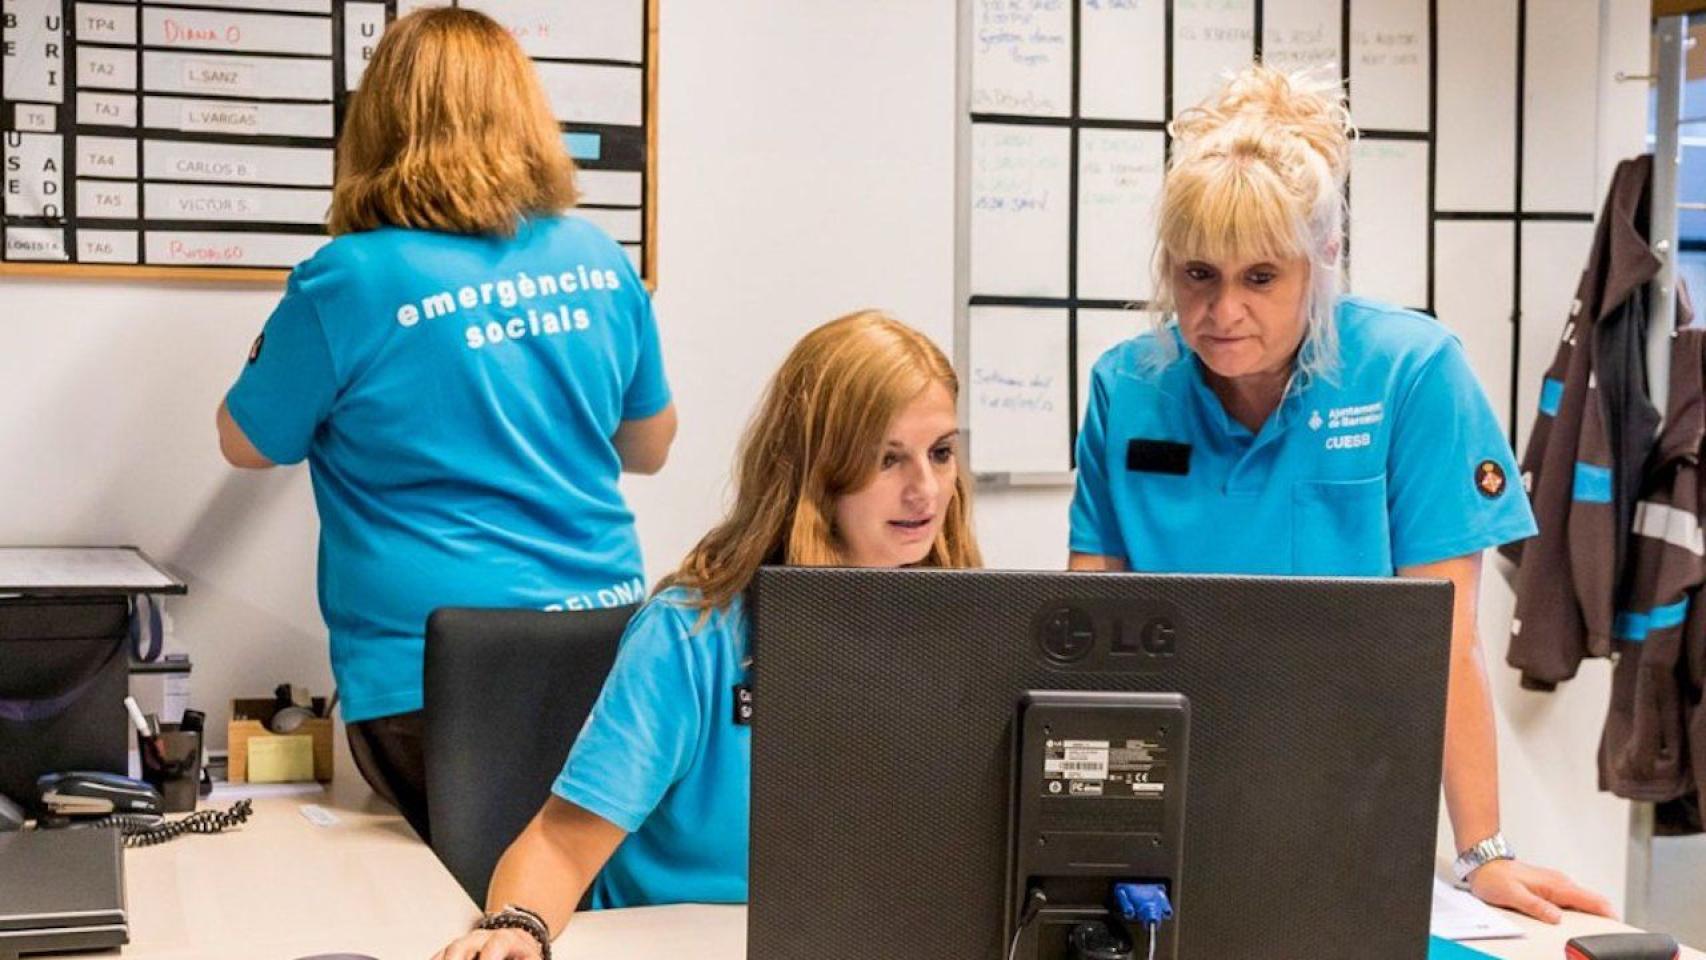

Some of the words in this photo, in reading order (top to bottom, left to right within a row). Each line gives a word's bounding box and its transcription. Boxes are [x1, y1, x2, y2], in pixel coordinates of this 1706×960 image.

[87, 18, 115, 31] TP4
[89, 62, 115, 75] TA2
[95, 103, 120, 117] TA3
[89, 153, 115, 166] TA4
[176, 160, 232, 175] CARLOS
[95, 194, 121, 207] TA5
[87, 242, 113, 254] TA6
[396, 264, 621, 328] emergències
[465, 304, 591, 350] socials
[1109, 616, 1177, 657] LG
